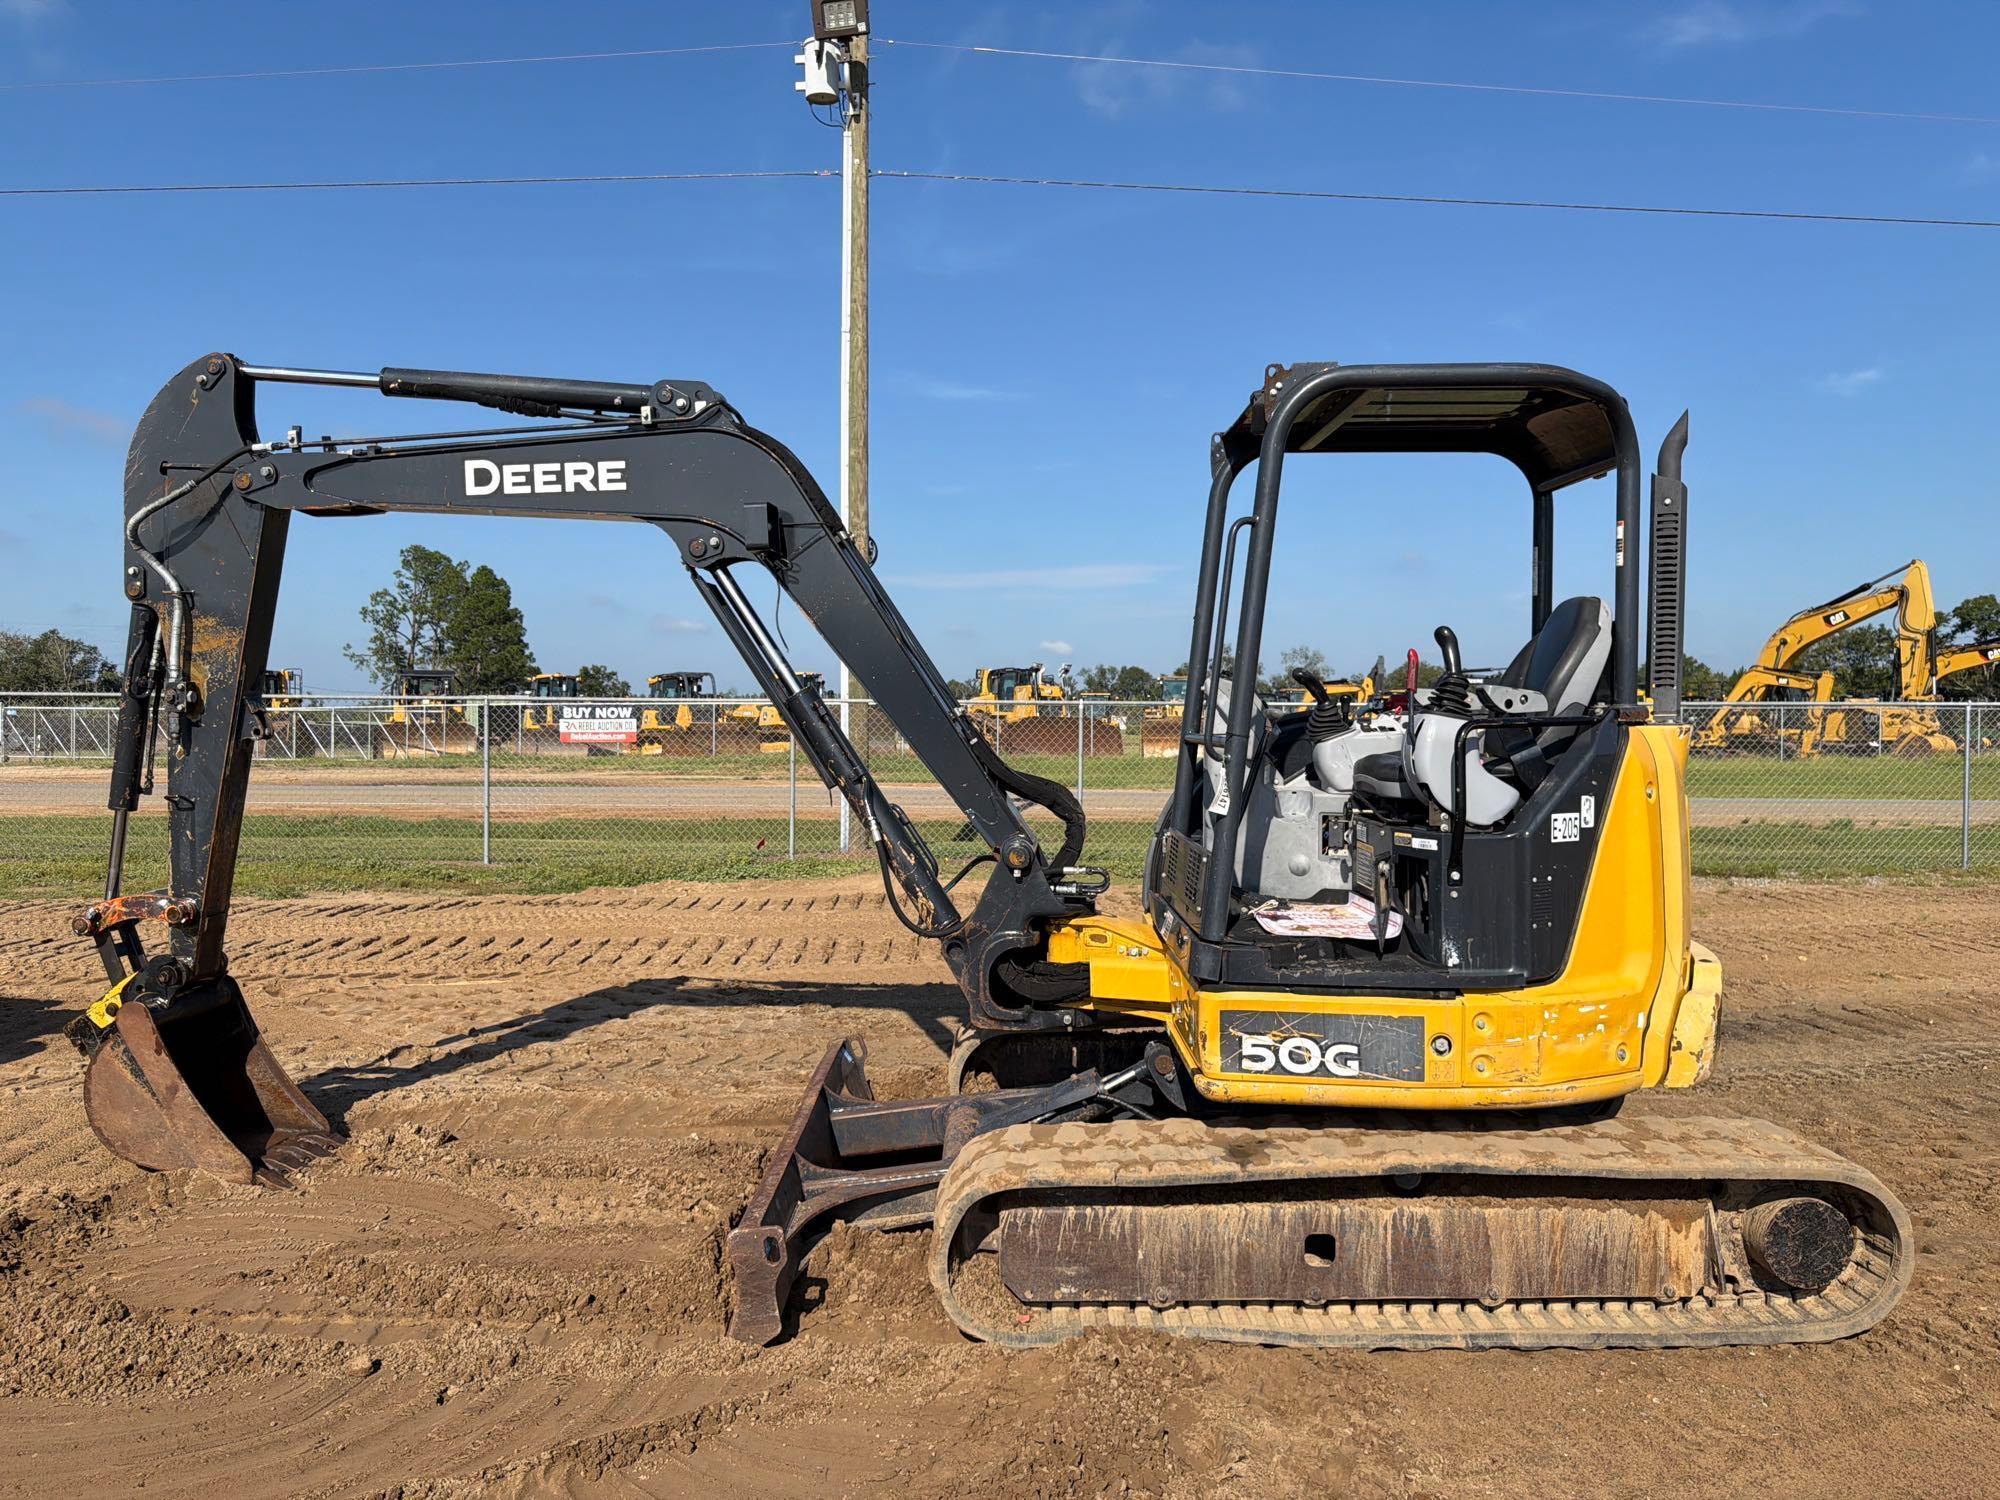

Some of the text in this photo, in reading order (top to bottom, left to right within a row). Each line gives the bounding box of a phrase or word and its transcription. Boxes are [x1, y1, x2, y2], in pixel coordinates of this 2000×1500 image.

[464, 459, 627, 496] DEERE
[1829, 611, 1846, 626] CAT
[562, 706, 633, 719] BUY NOW
[578, 721, 596, 731] REBEL
[597, 721, 623, 731] AUCTION
[1552, 816, 1579, 840] E-205
[1241, 1034, 1360, 1077] 50G
